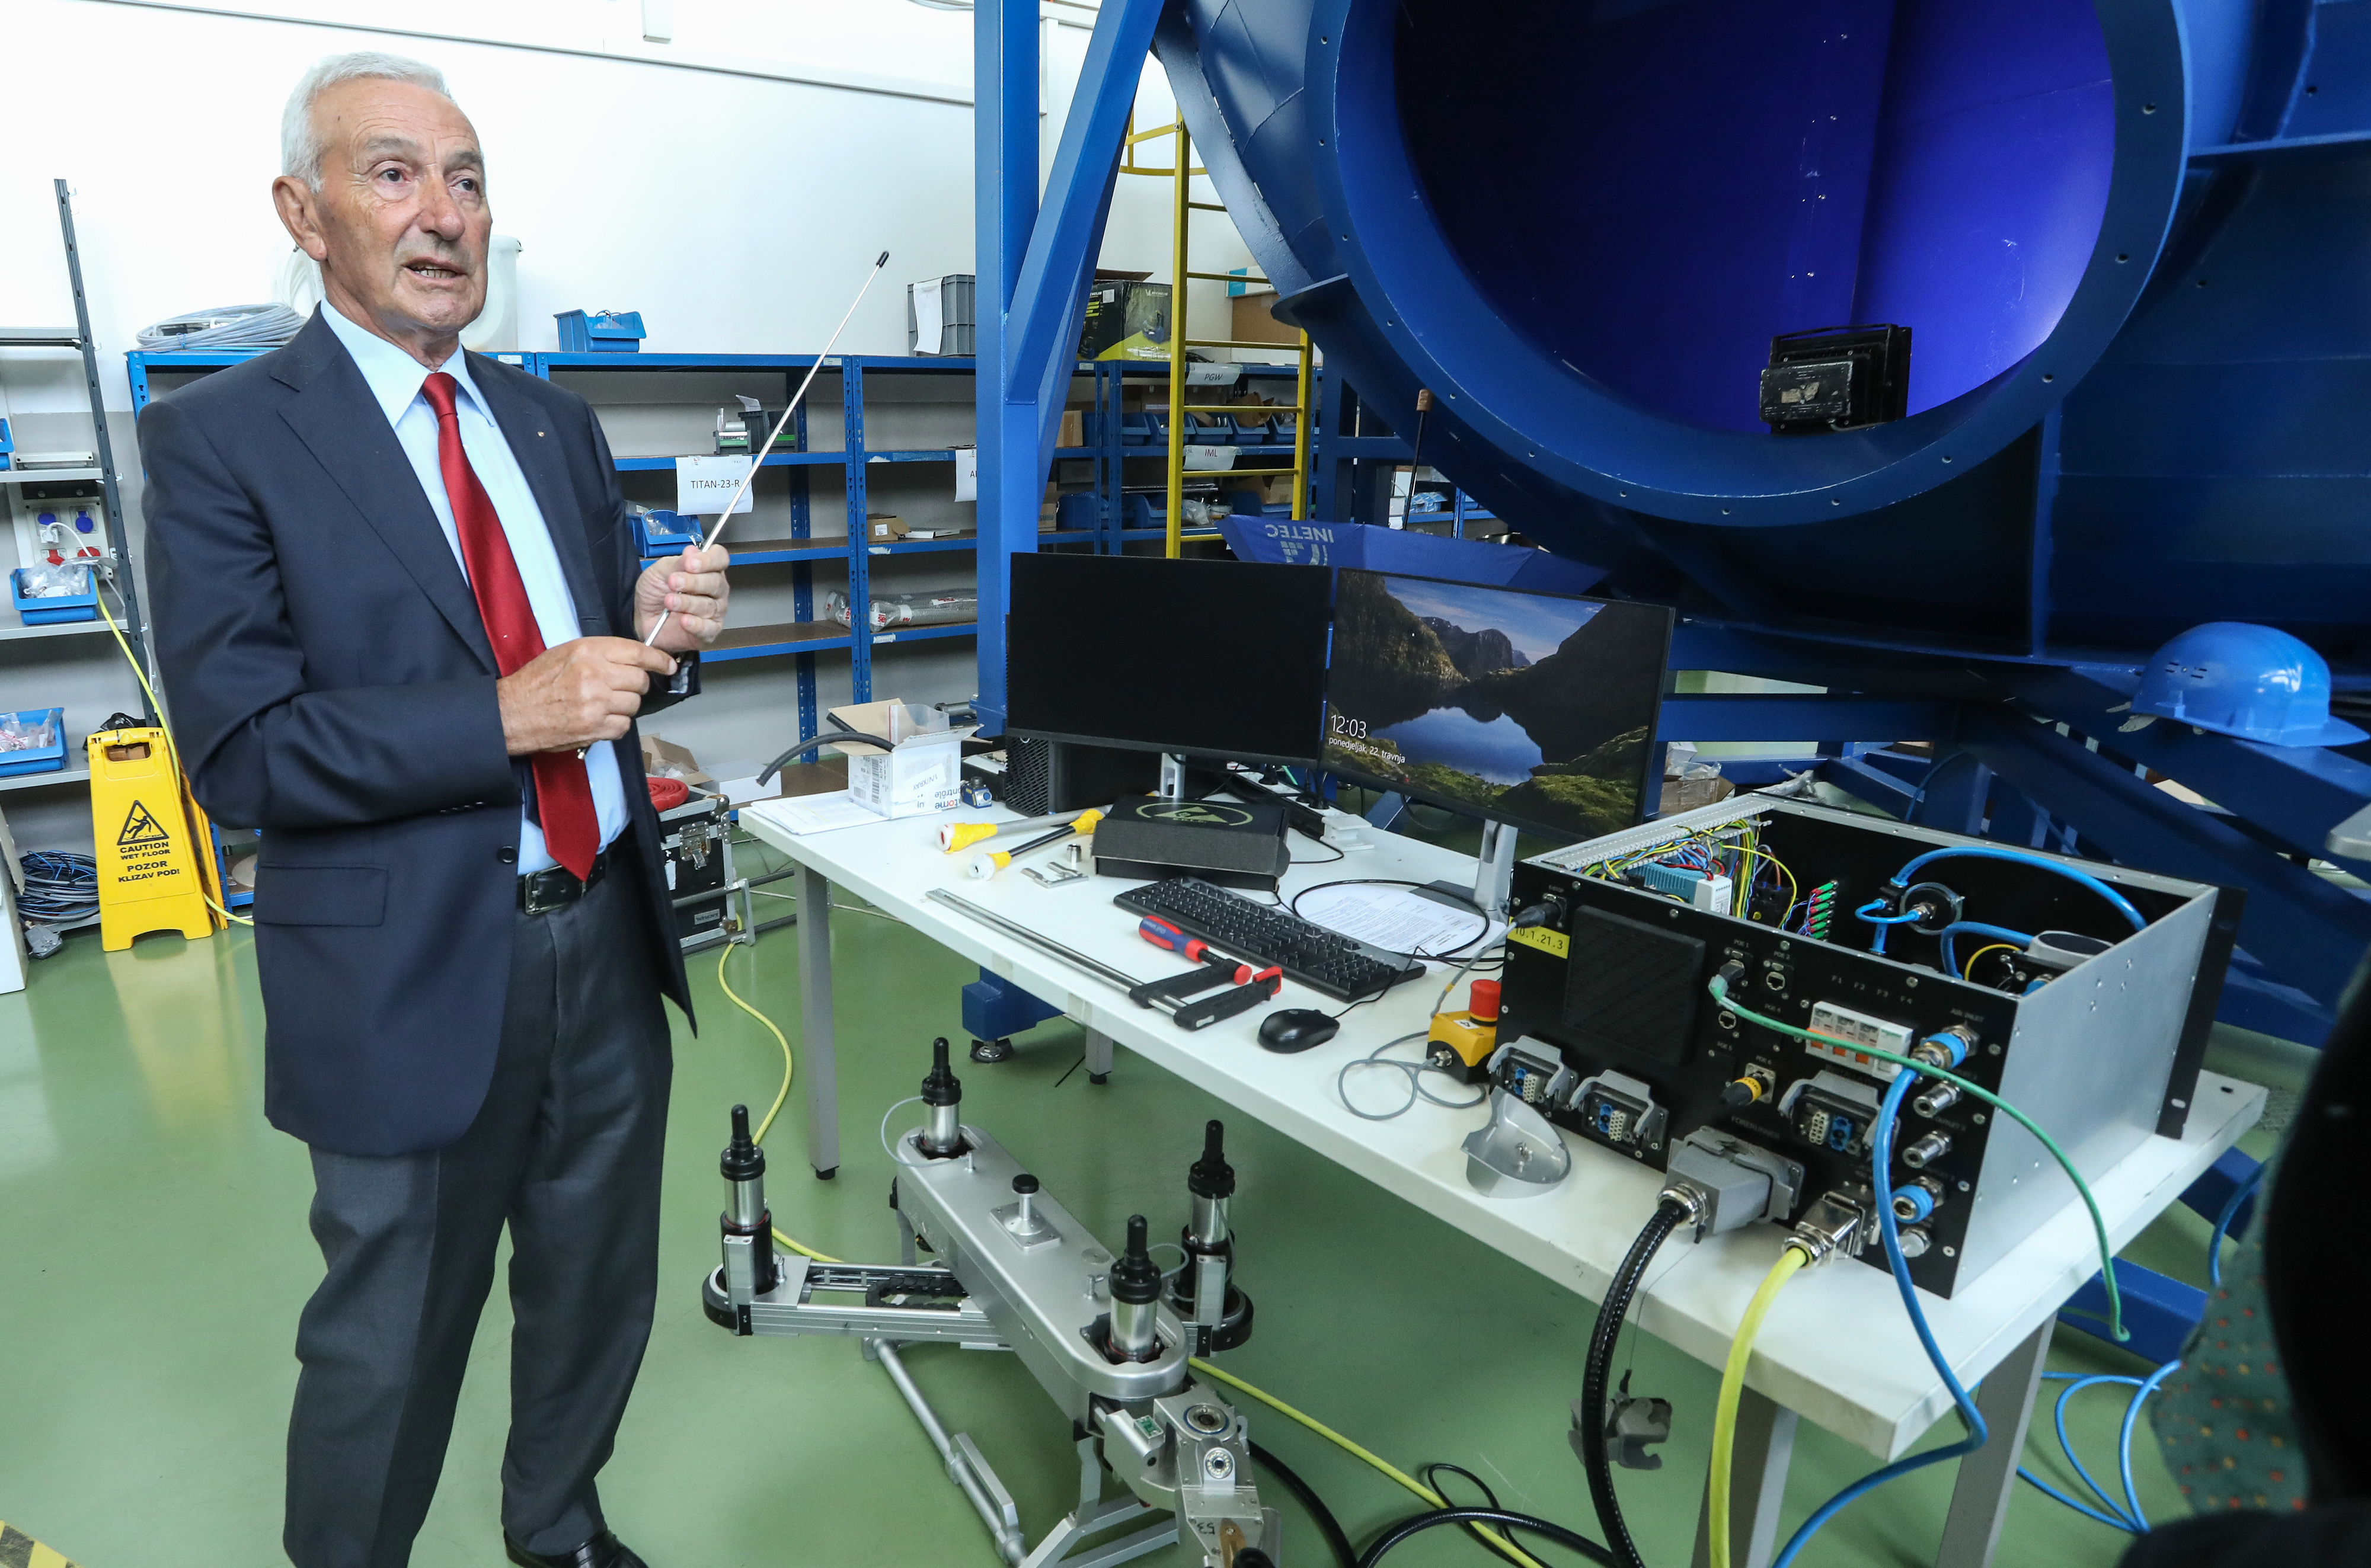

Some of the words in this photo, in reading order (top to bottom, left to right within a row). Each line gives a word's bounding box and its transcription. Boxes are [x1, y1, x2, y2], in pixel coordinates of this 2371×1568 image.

[1204, 449, 1218, 457] IML
[691, 479, 740, 488] TITAN-23-R
[1265, 524, 1334, 543] INETEC
[1331, 714, 1367, 739] 12:03
[1329, 737, 1368, 754] ponedjeljak,
[1369, 745, 1380, 756] 22.
[1381, 750, 1405, 764] travnja
[120, 841, 170, 853] CAUTION
[142, 849, 171, 857] FLOOR
[127, 860, 168, 872] POZOR
[118, 872, 154, 883] KLIZAV
[156, 869, 180, 877] POD!
[1515, 927, 1564, 950] 10.1.21.3
